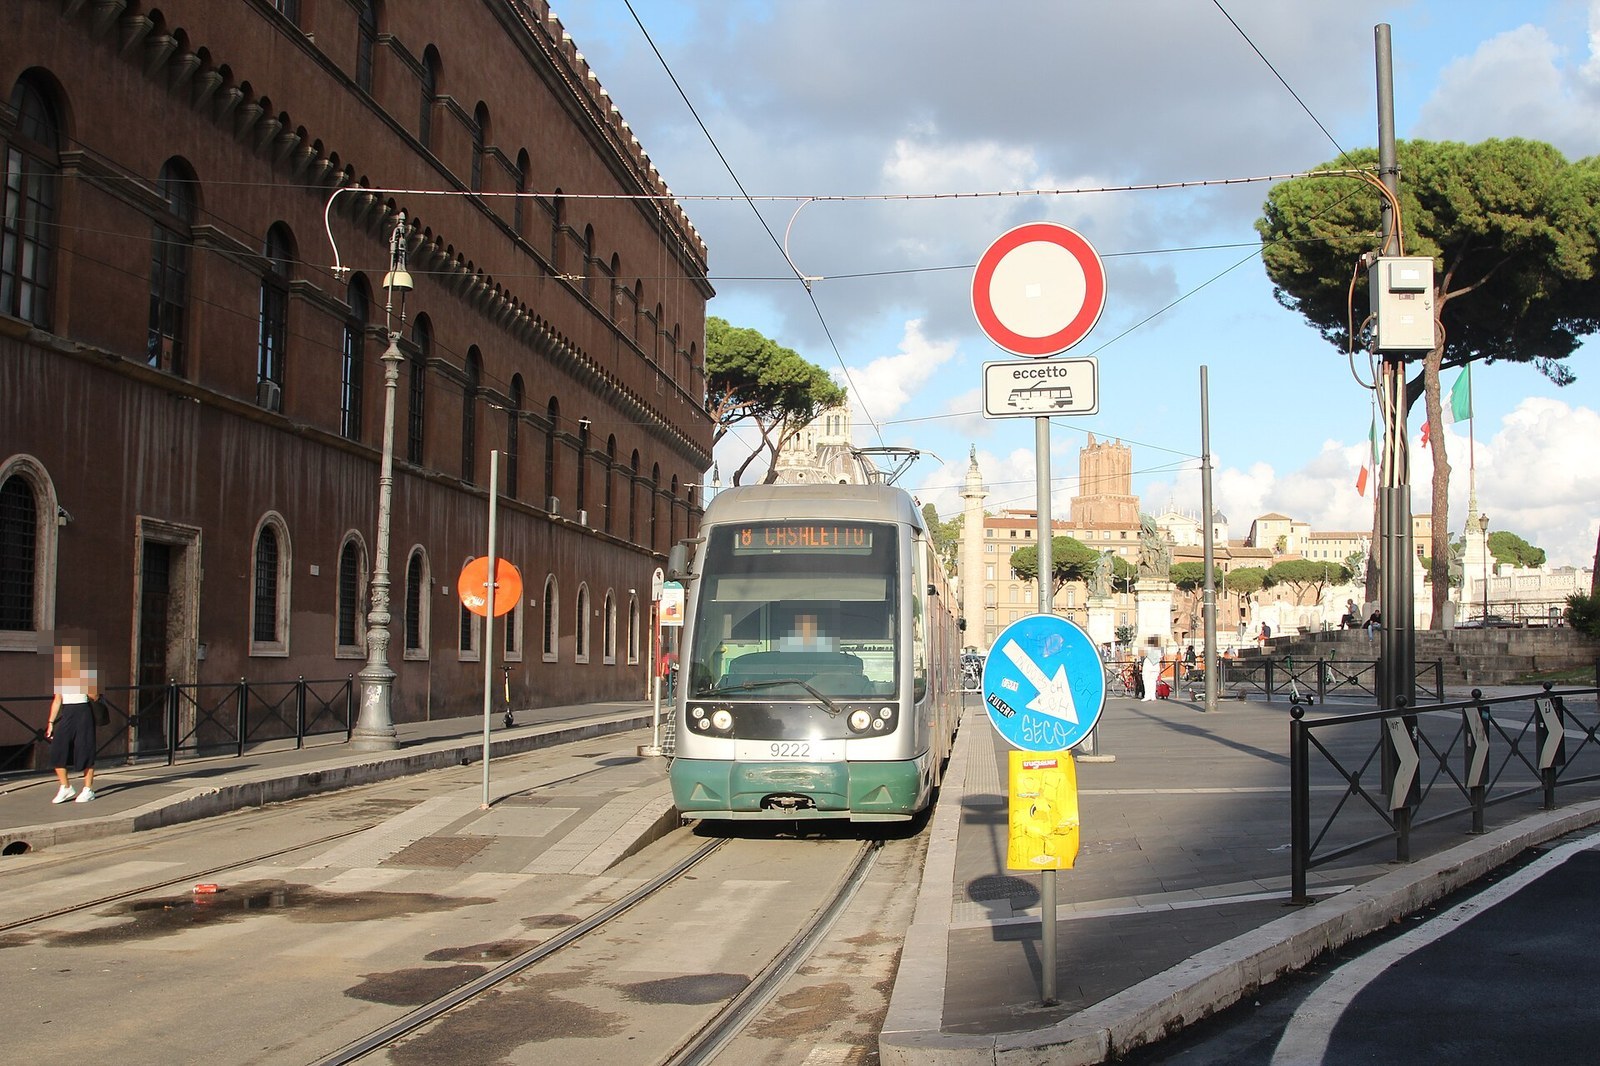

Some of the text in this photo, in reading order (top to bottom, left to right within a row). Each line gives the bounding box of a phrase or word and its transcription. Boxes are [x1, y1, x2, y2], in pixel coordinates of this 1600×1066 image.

[1012, 366, 1068, 379] eccetto
[741, 528, 753, 547] 8
[987, 694, 1016, 718] FULCRO
[1021, 714, 1075, 747] SECO
[770, 743, 810, 757] 9222
